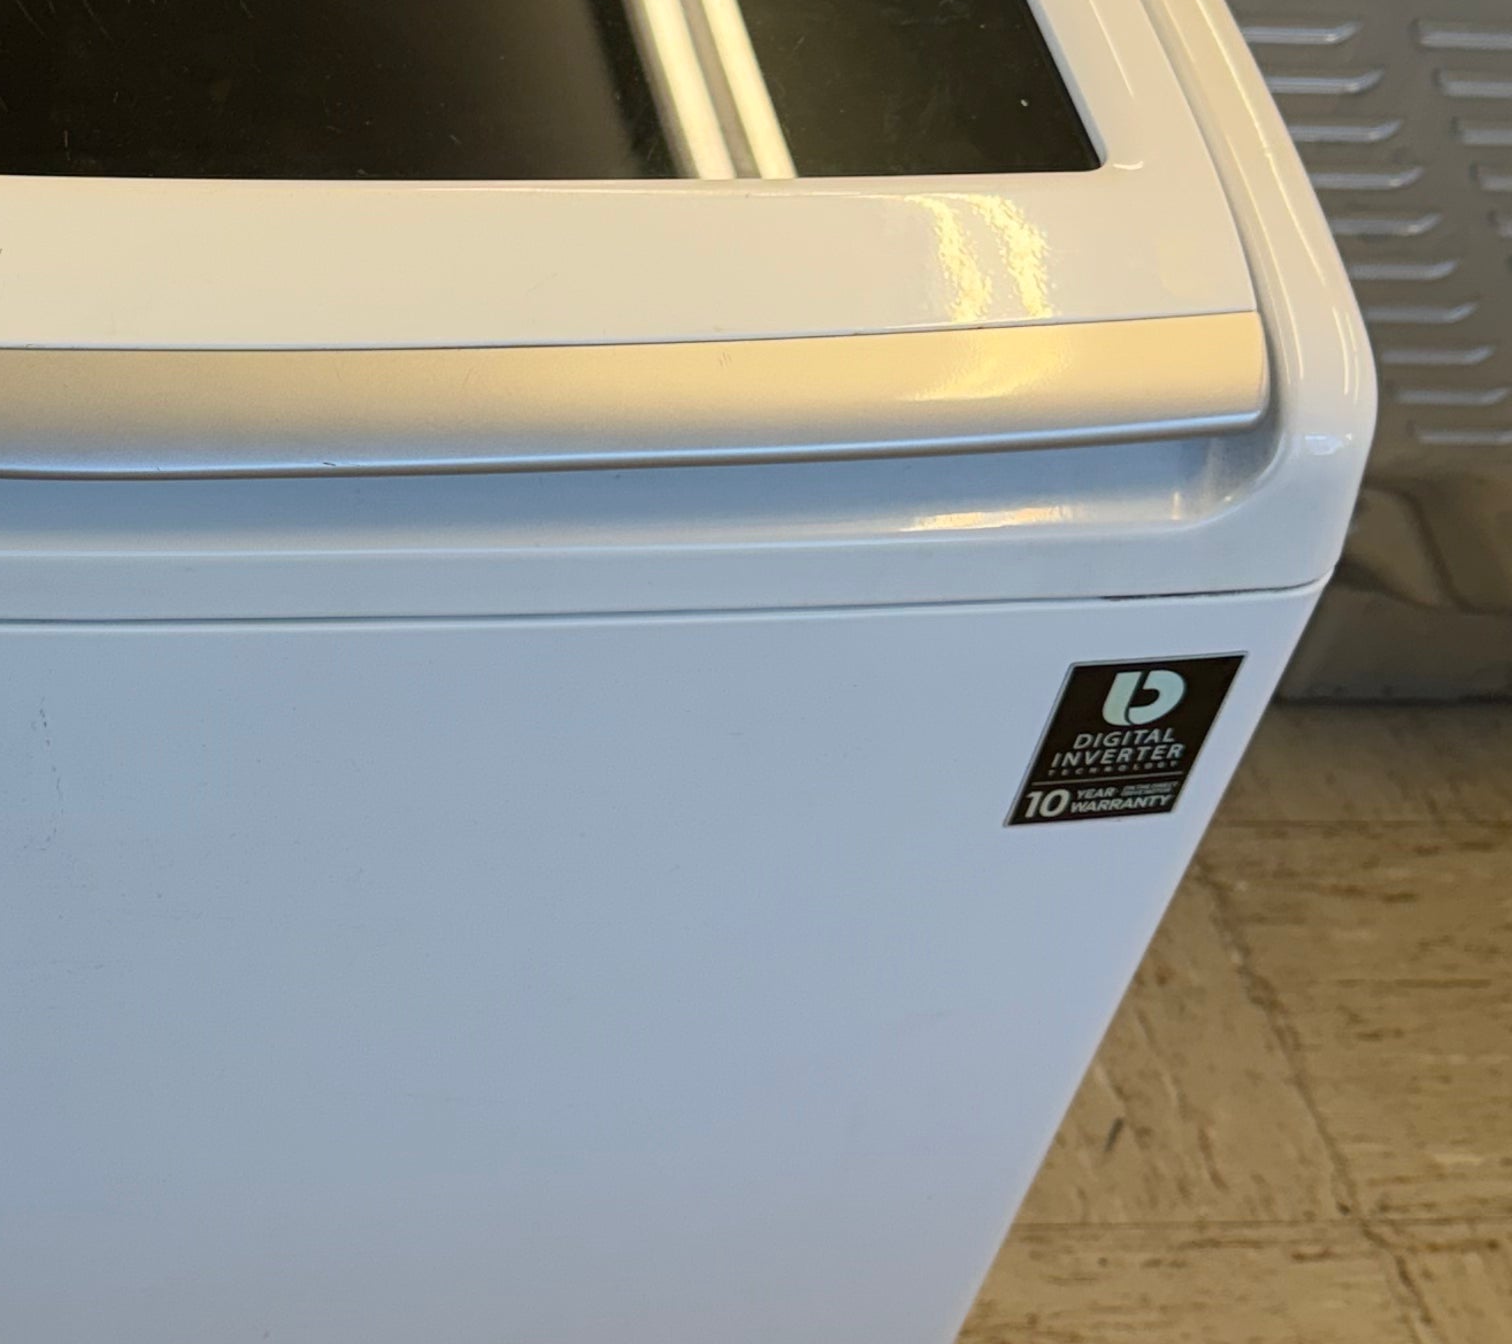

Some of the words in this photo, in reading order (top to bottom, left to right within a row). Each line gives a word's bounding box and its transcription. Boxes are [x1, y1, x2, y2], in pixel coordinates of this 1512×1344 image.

[1072, 727, 1176, 750] DIGITAL
[1051, 743, 1185, 769] INVERTER
[1024, 787, 1072, 819] 10
[1075, 786, 1118, 801] YEAR
[1070, 794, 1174, 814] WARRANTY
